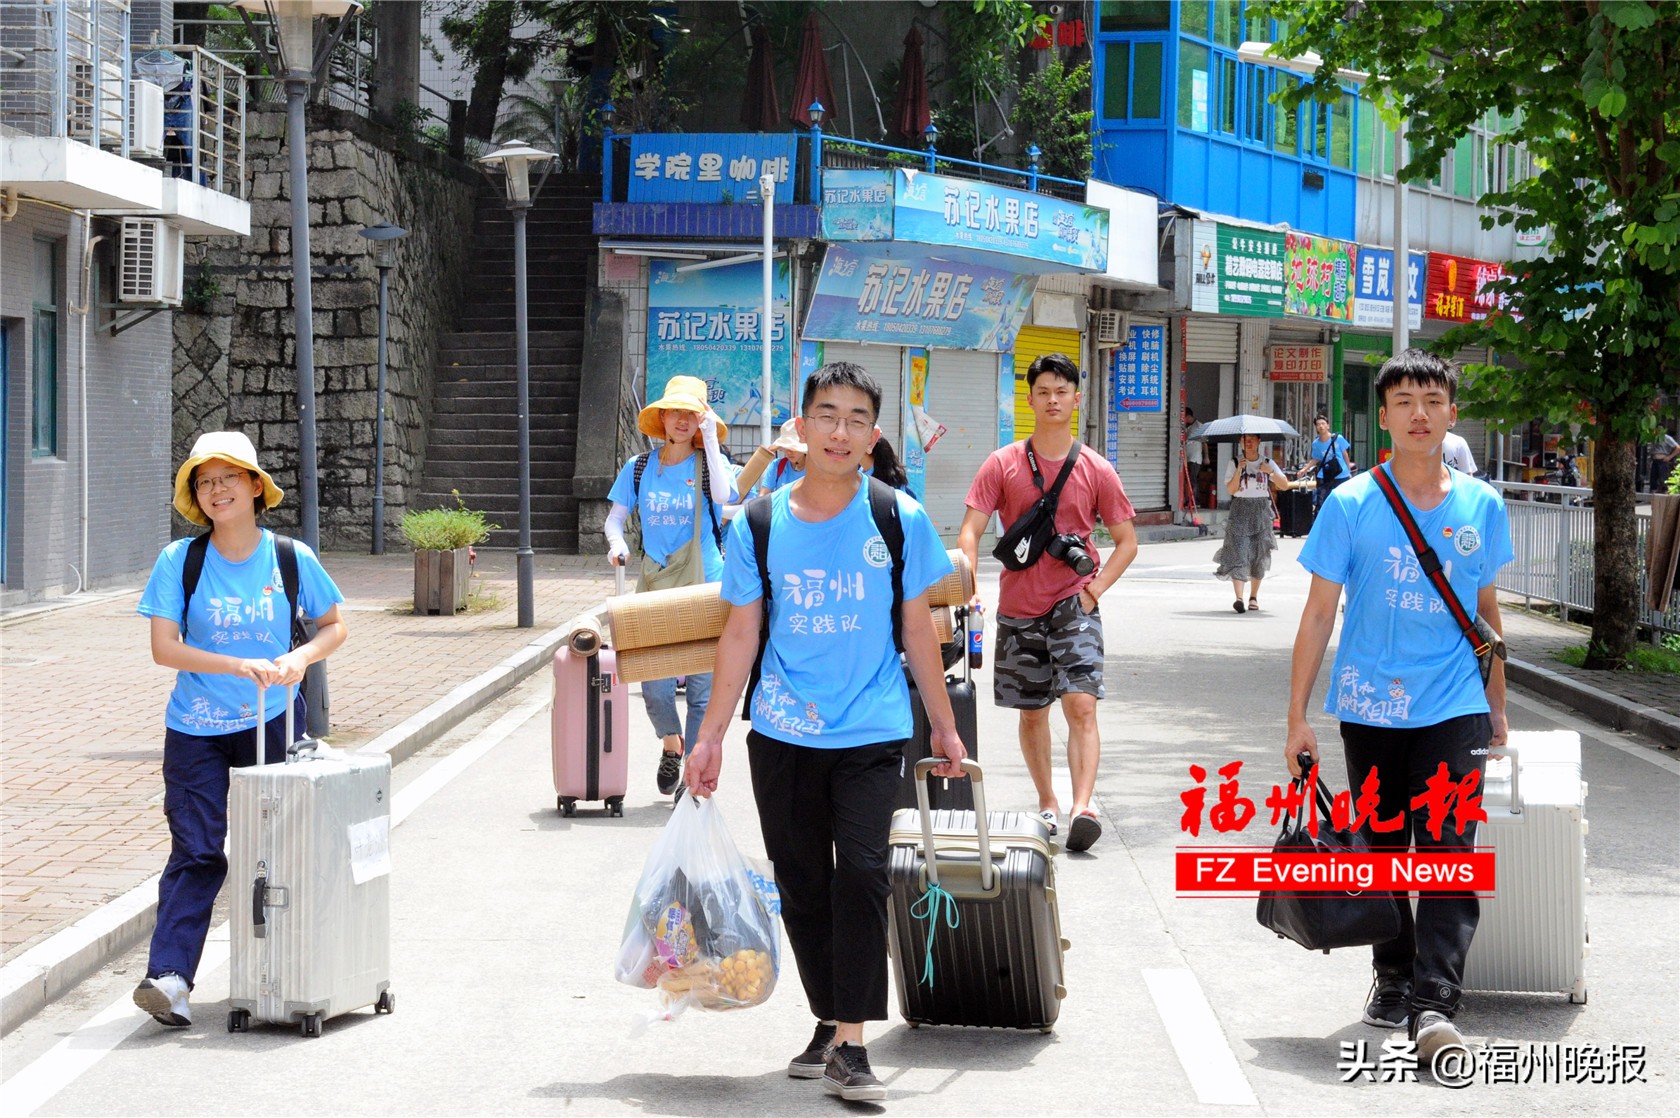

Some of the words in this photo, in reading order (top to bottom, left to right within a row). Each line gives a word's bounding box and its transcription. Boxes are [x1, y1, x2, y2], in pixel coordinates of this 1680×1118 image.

[635, 152, 790, 183] 学院里咖啡
[825, 188, 886, 204] 苏记水果店
[943, 186, 1040, 239] 苏记水果店
[1362, 256, 1419, 299] 雪岚文
[857, 263, 974, 321] 苏记水果店
[657, 311, 786, 342] 苏记水果店
[1142, 330, 1160, 339] 快修
[693, 344, 737, 352] 18050420339
[1142, 341, 1159, 350] 电脑
[1274, 348, 1322, 358] 论文制作
[1119, 364, 1136, 373] 贴膜
[1141, 364, 1158, 372] 除尘
[1274, 360, 1322, 370] 复印打印
[1119, 375, 1135, 384] 安装
[1141, 375, 1158, 384] 系统
[1118, 386, 1135, 396] 考试
[1141, 386, 1158, 396] 耳机
[645, 491, 694, 513] 福州
[647, 514, 692, 527] 实践队
[1014, 537, 1029, 555] NIKE
[782, 569, 866, 610] 福州
[206, 596, 274, 628] 福州
[788, 613, 862, 635] 实践队
[211, 630, 274, 645] 实践队
[1340, 665, 1376, 698] 我和
